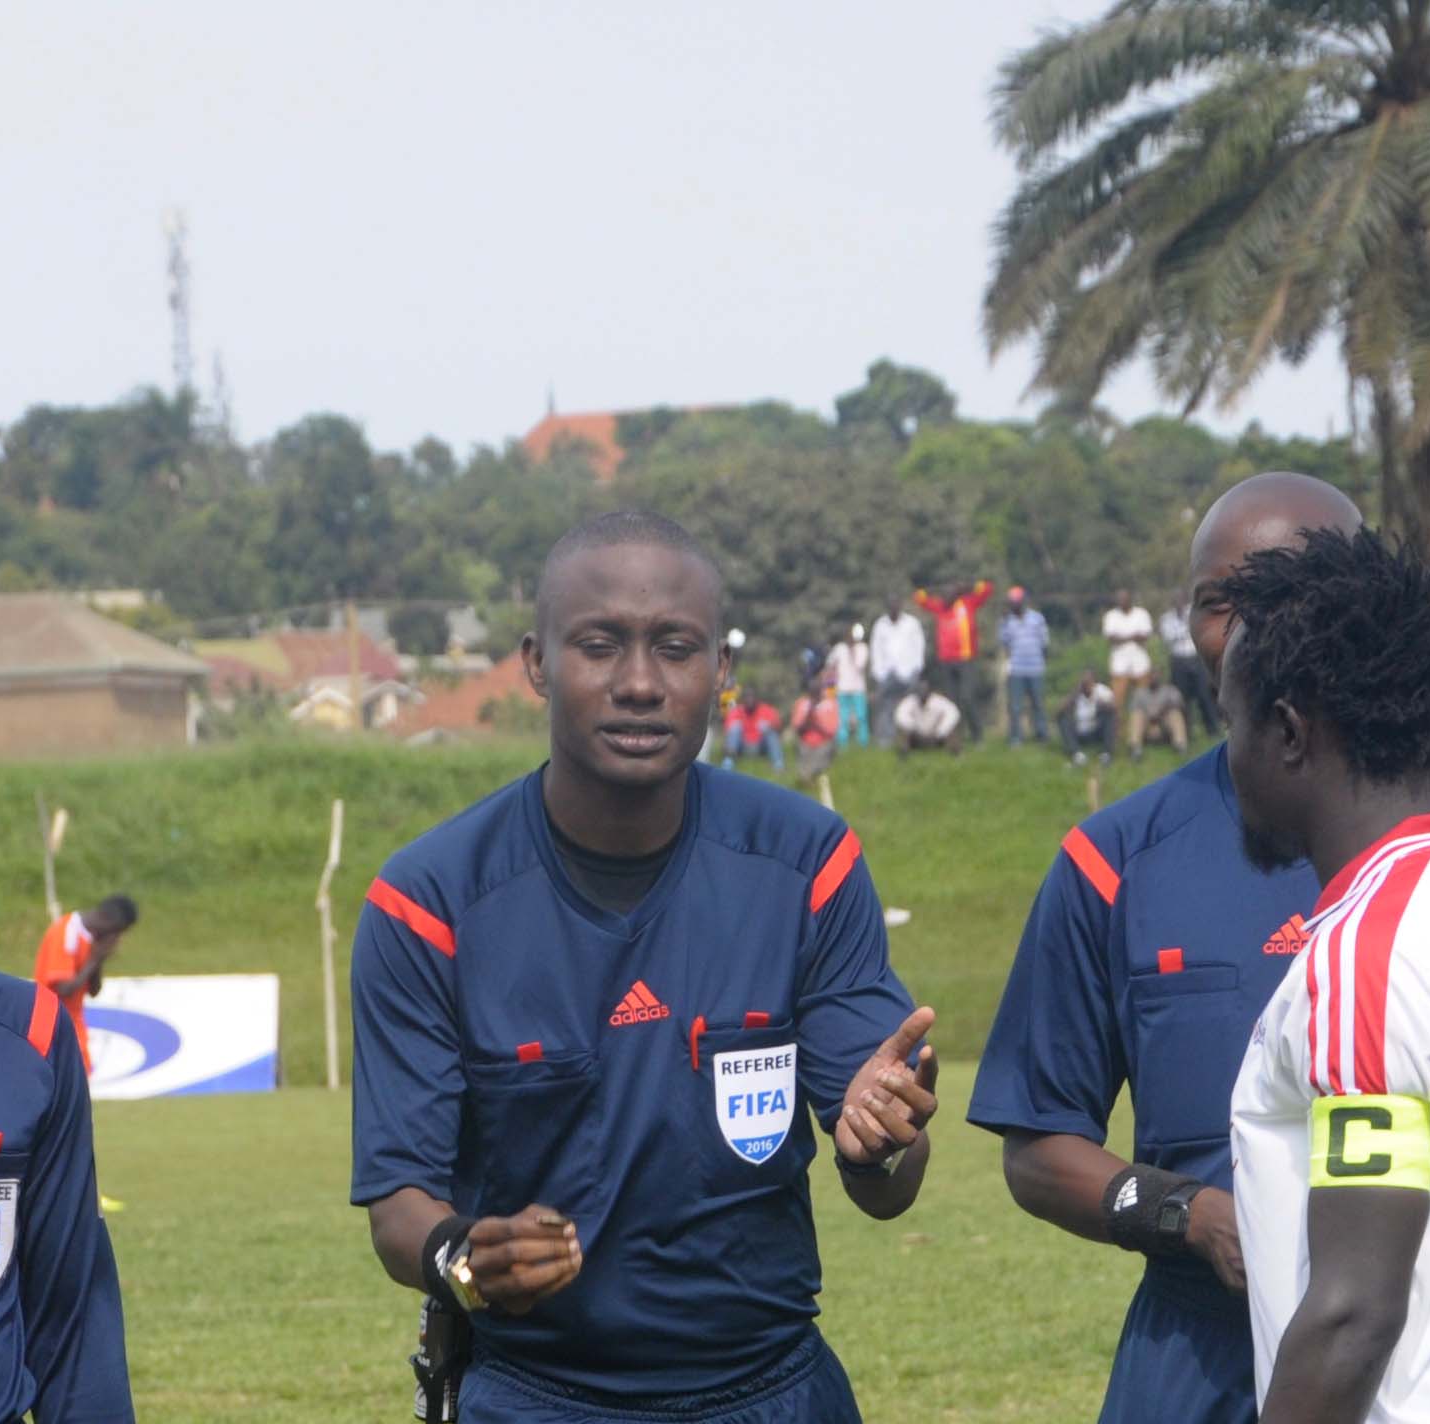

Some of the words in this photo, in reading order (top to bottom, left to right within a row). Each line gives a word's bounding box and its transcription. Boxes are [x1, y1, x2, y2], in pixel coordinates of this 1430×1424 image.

[1262, 939, 1307, 955] adid
[609, 1004, 670, 1027] adidas
[721, 1053, 793, 1076] REFEREE
[728, 1088, 788, 1119] FIFA
[745, 1139, 774, 1155] 2016
[1325, 1106, 1393, 1178] C
